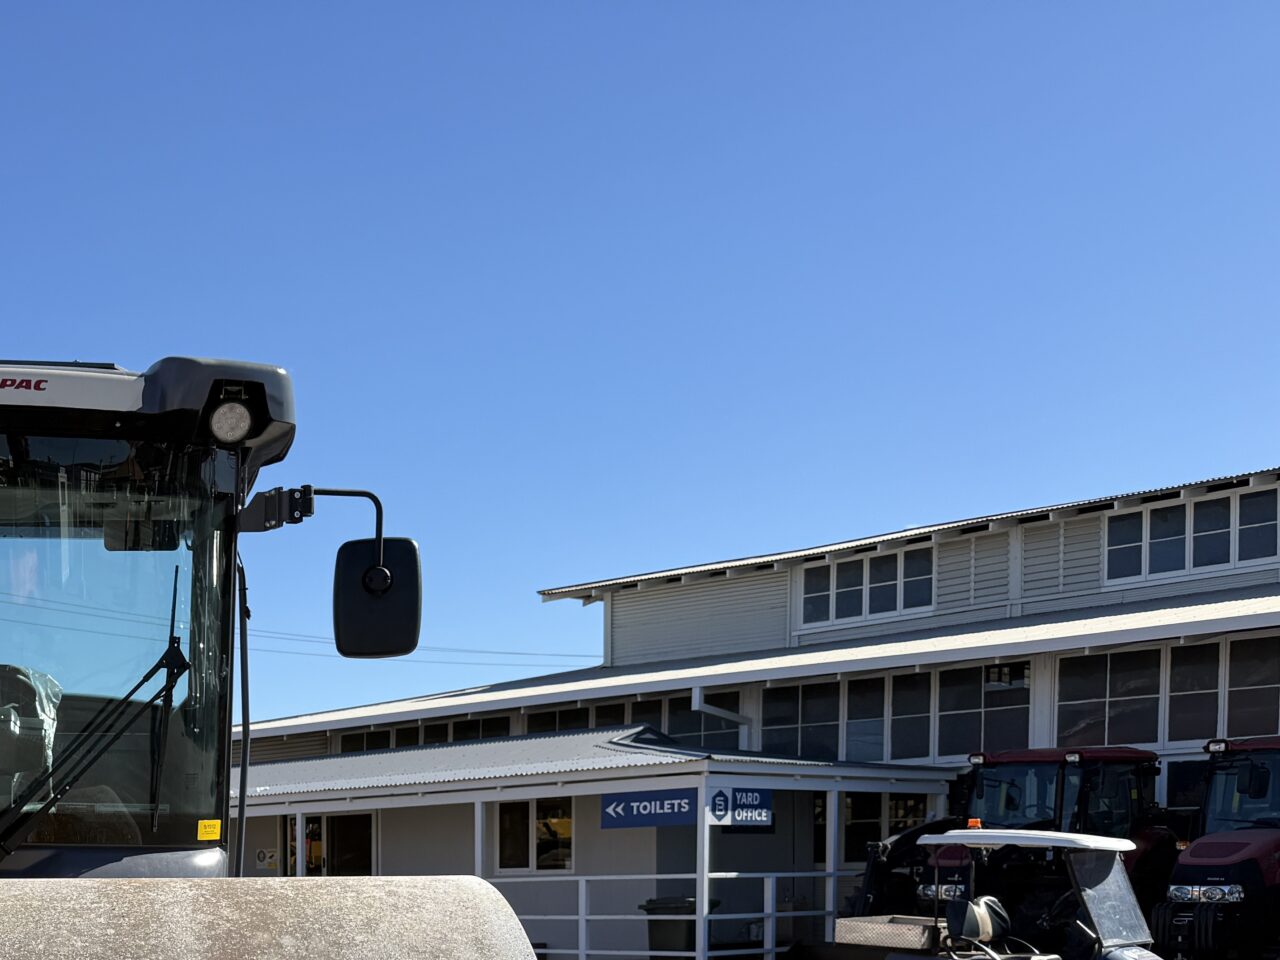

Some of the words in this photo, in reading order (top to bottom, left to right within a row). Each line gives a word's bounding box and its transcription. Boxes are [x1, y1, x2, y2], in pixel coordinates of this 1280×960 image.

[735, 791, 761, 805] YARD
[630, 799, 690, 815] TOILETS
[734, 808, 768, 821] OFFICE
